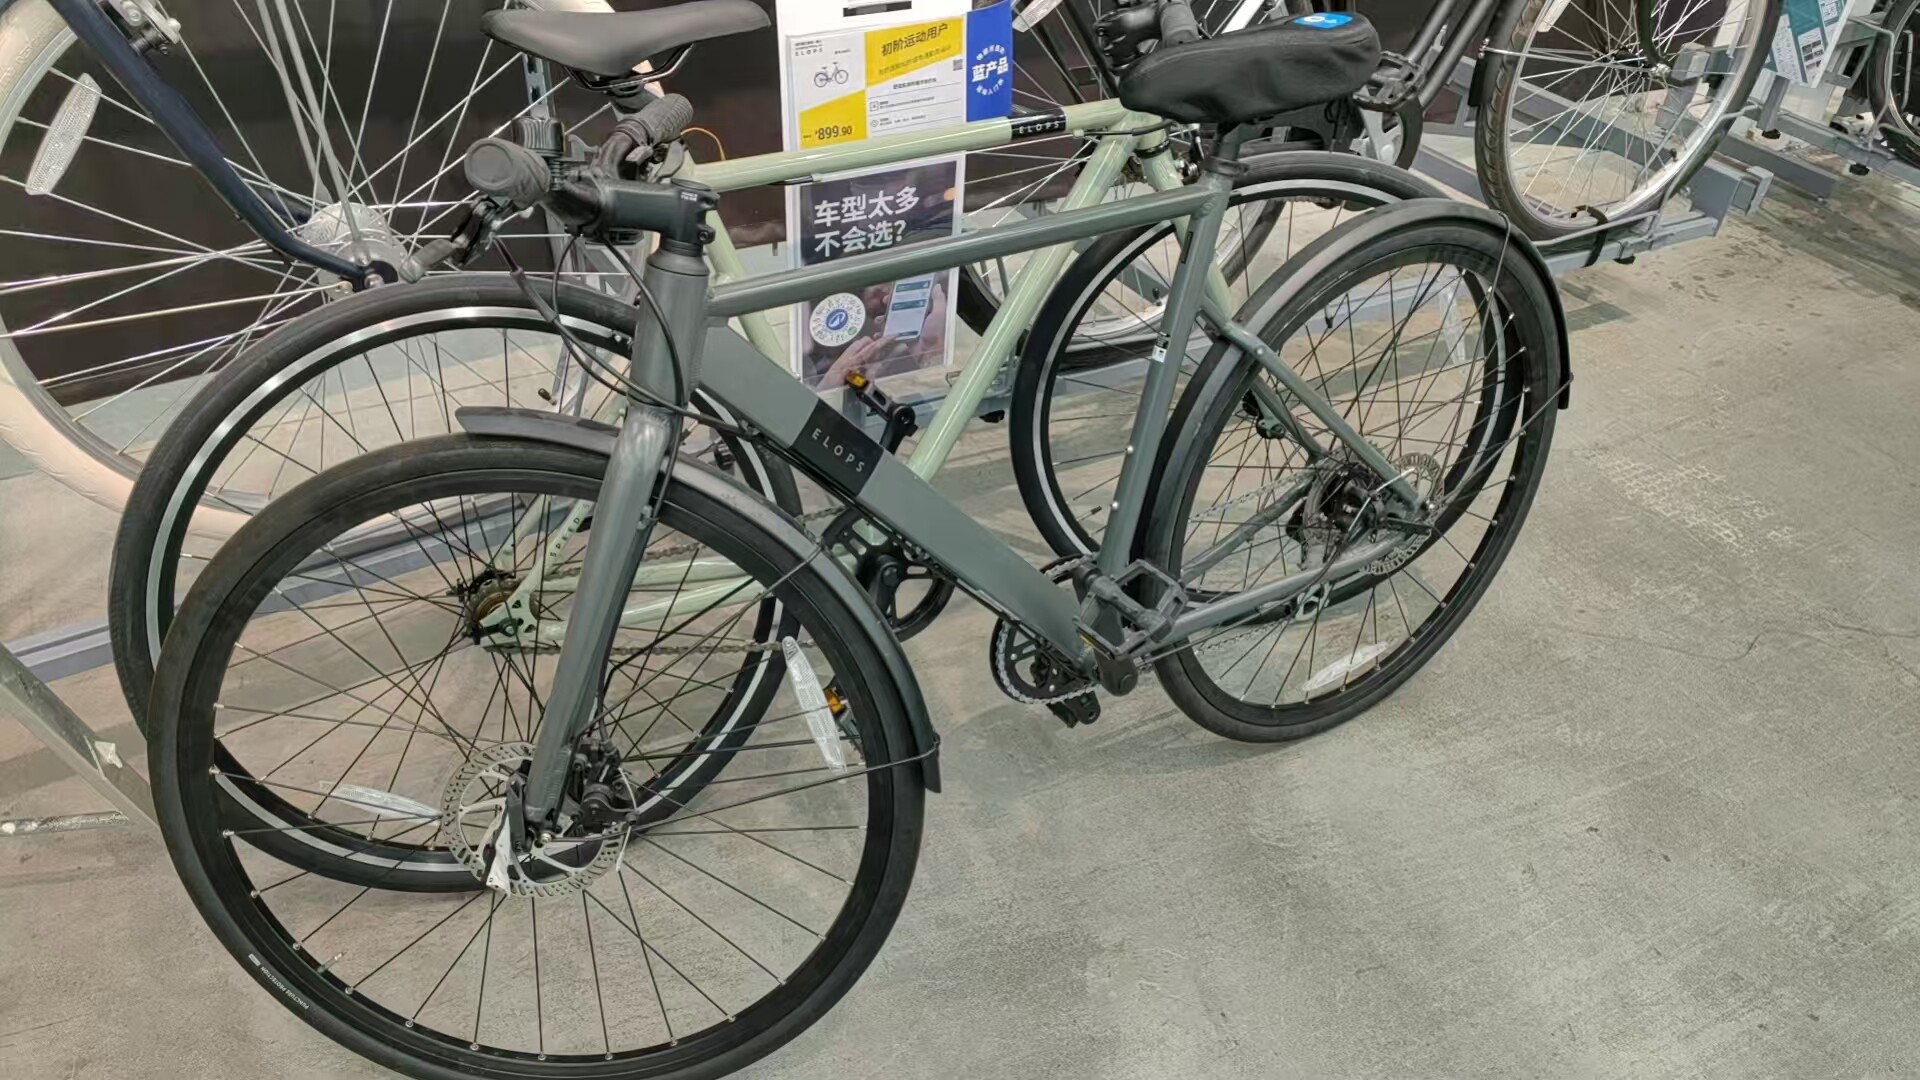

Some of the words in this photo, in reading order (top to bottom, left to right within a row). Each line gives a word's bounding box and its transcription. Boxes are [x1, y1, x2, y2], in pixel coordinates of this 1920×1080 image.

[795, 47, 823, 57] ELOPS
[881, 22, 948, 57] 初阶运动用户
[971, 56, 1009, 82] 蓝产品
[1018, 121, 1060, 134] ELOPS
[814, 186, 920, 227] 车型太多
[811, 428, 865, 473] ELOPS
[549, 517, 581, 558] SPEED
[261, 966, 287, 993] PROTECTION
[285, 988, 310, 1010] PUNCTURE
